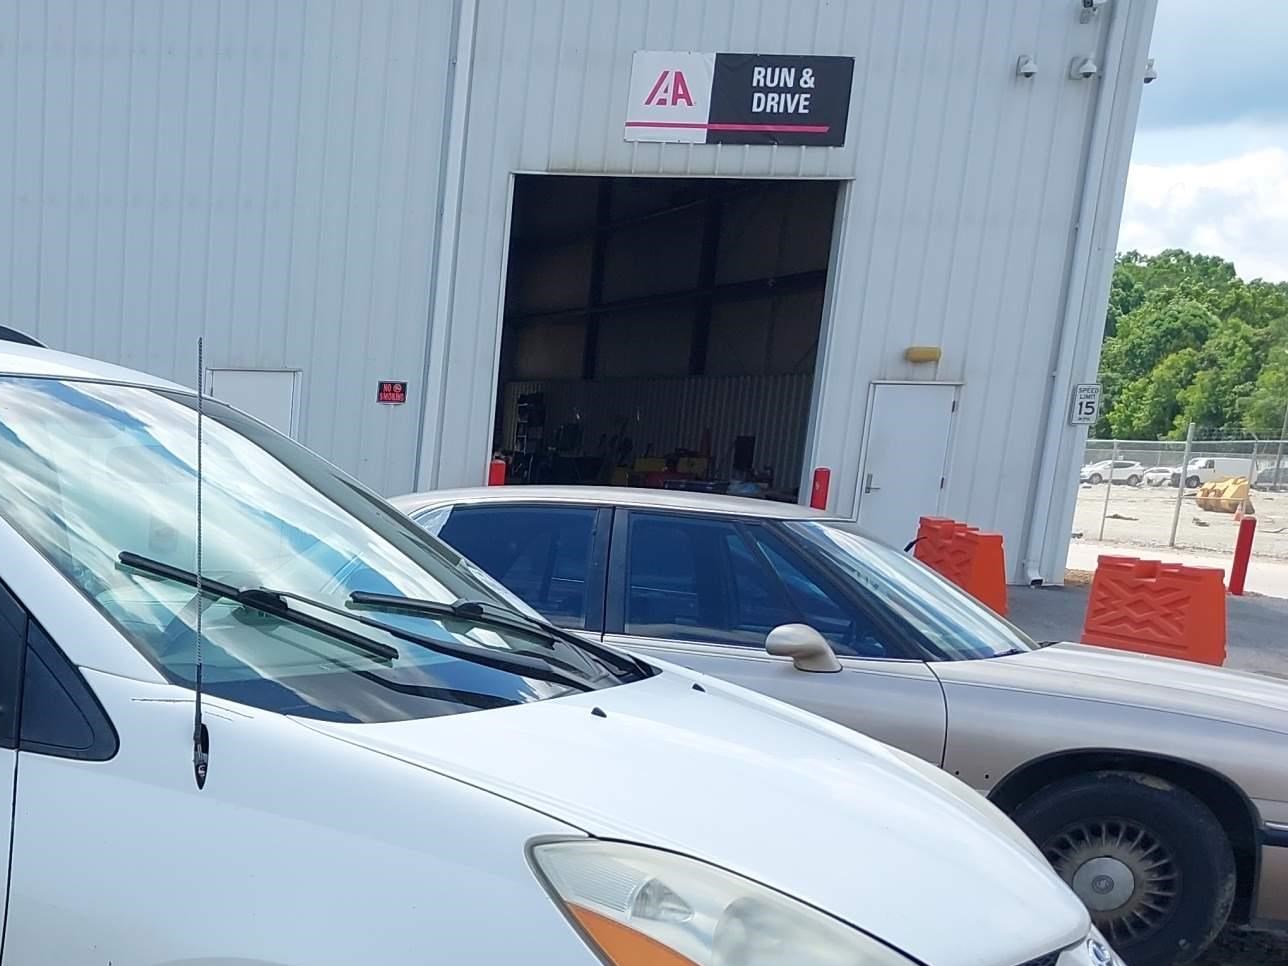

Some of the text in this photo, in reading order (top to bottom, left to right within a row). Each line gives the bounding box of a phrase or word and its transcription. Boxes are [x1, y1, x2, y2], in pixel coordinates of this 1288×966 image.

[752, 66, 815, 89] RUN &
[752, 92, 812, 114] DRIVE
[383, 383, 392, 392] NO
[379, 392, 404, 401] SMOKING
[1078, 401, 1095, 415] 15
